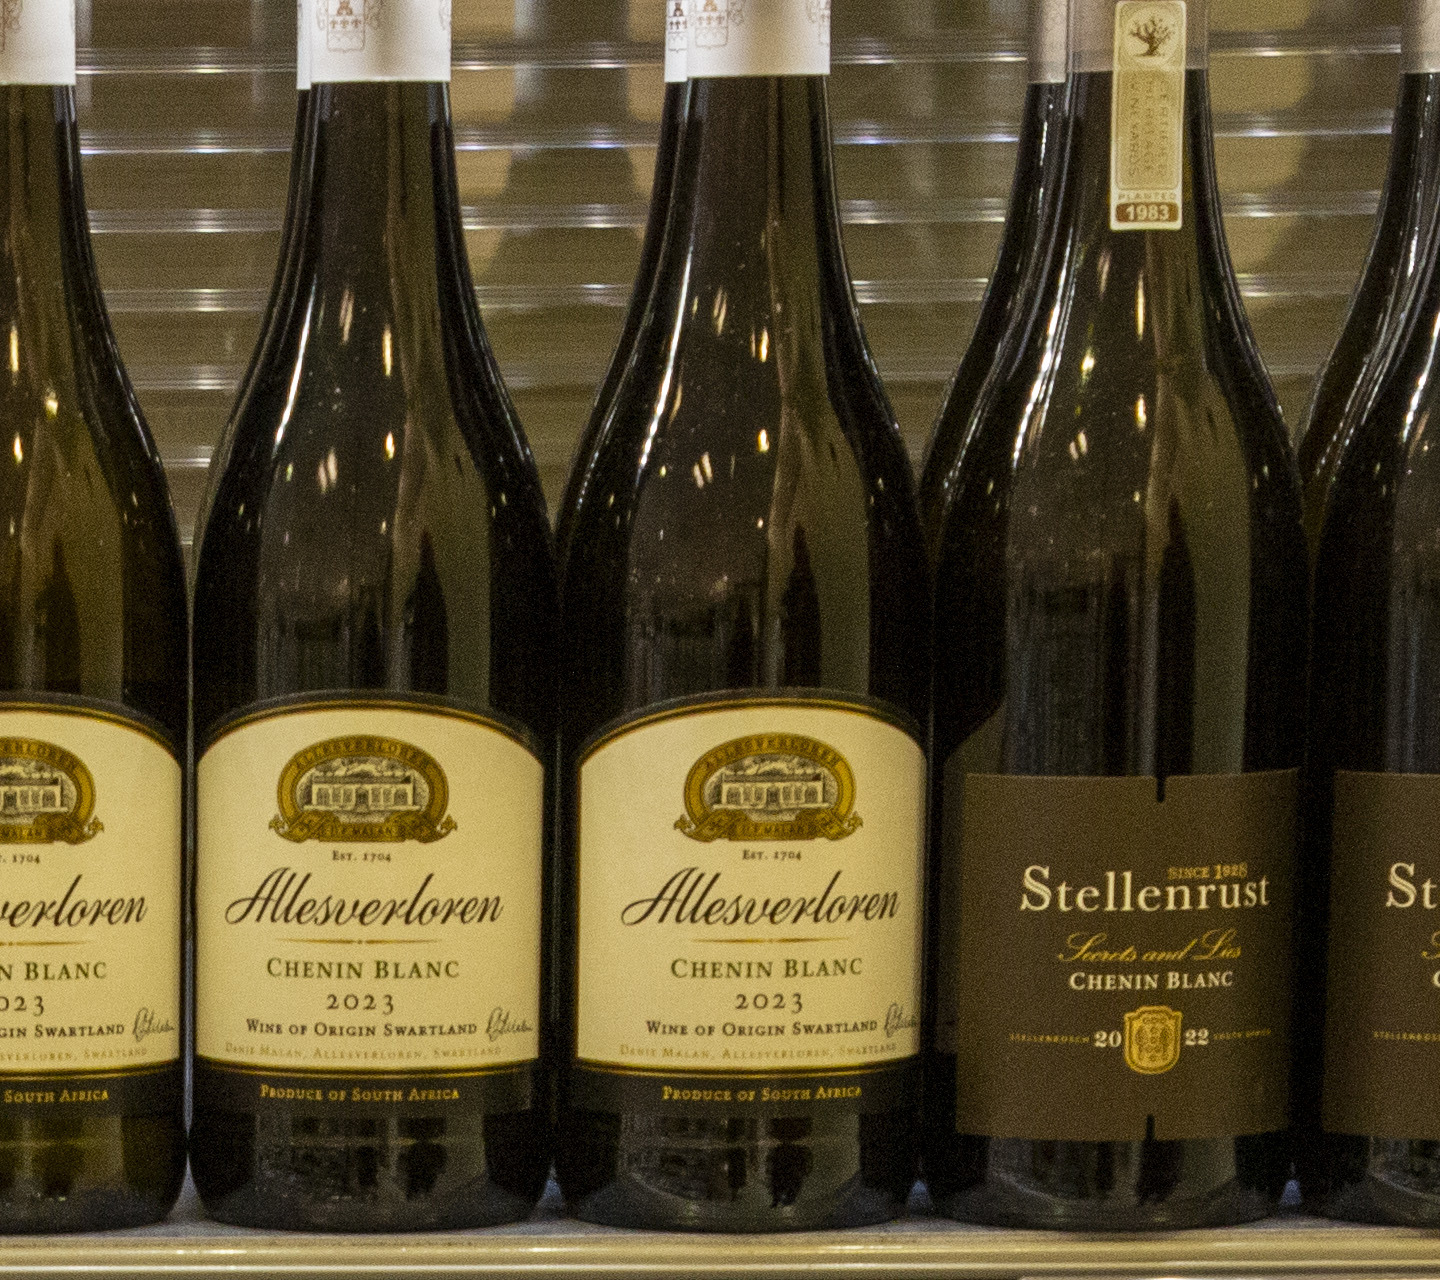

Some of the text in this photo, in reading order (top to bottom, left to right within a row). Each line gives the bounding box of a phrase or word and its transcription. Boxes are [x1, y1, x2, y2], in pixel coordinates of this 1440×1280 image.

[1125, 204, 1169, 220] 1983
[224, 866, 504, 928] Allesverloren
[620, 865, 901, 929] Allesverloren
[1020, 863, 1271, 913] Stellenrust
[24, 958, 107, 983] BLANC
[671, 956, 864, 979] CHENIN BLANC
[1069, 969, 1235, 990] CHENIN BLANC
[736, 990, 803, 1011] 2023
